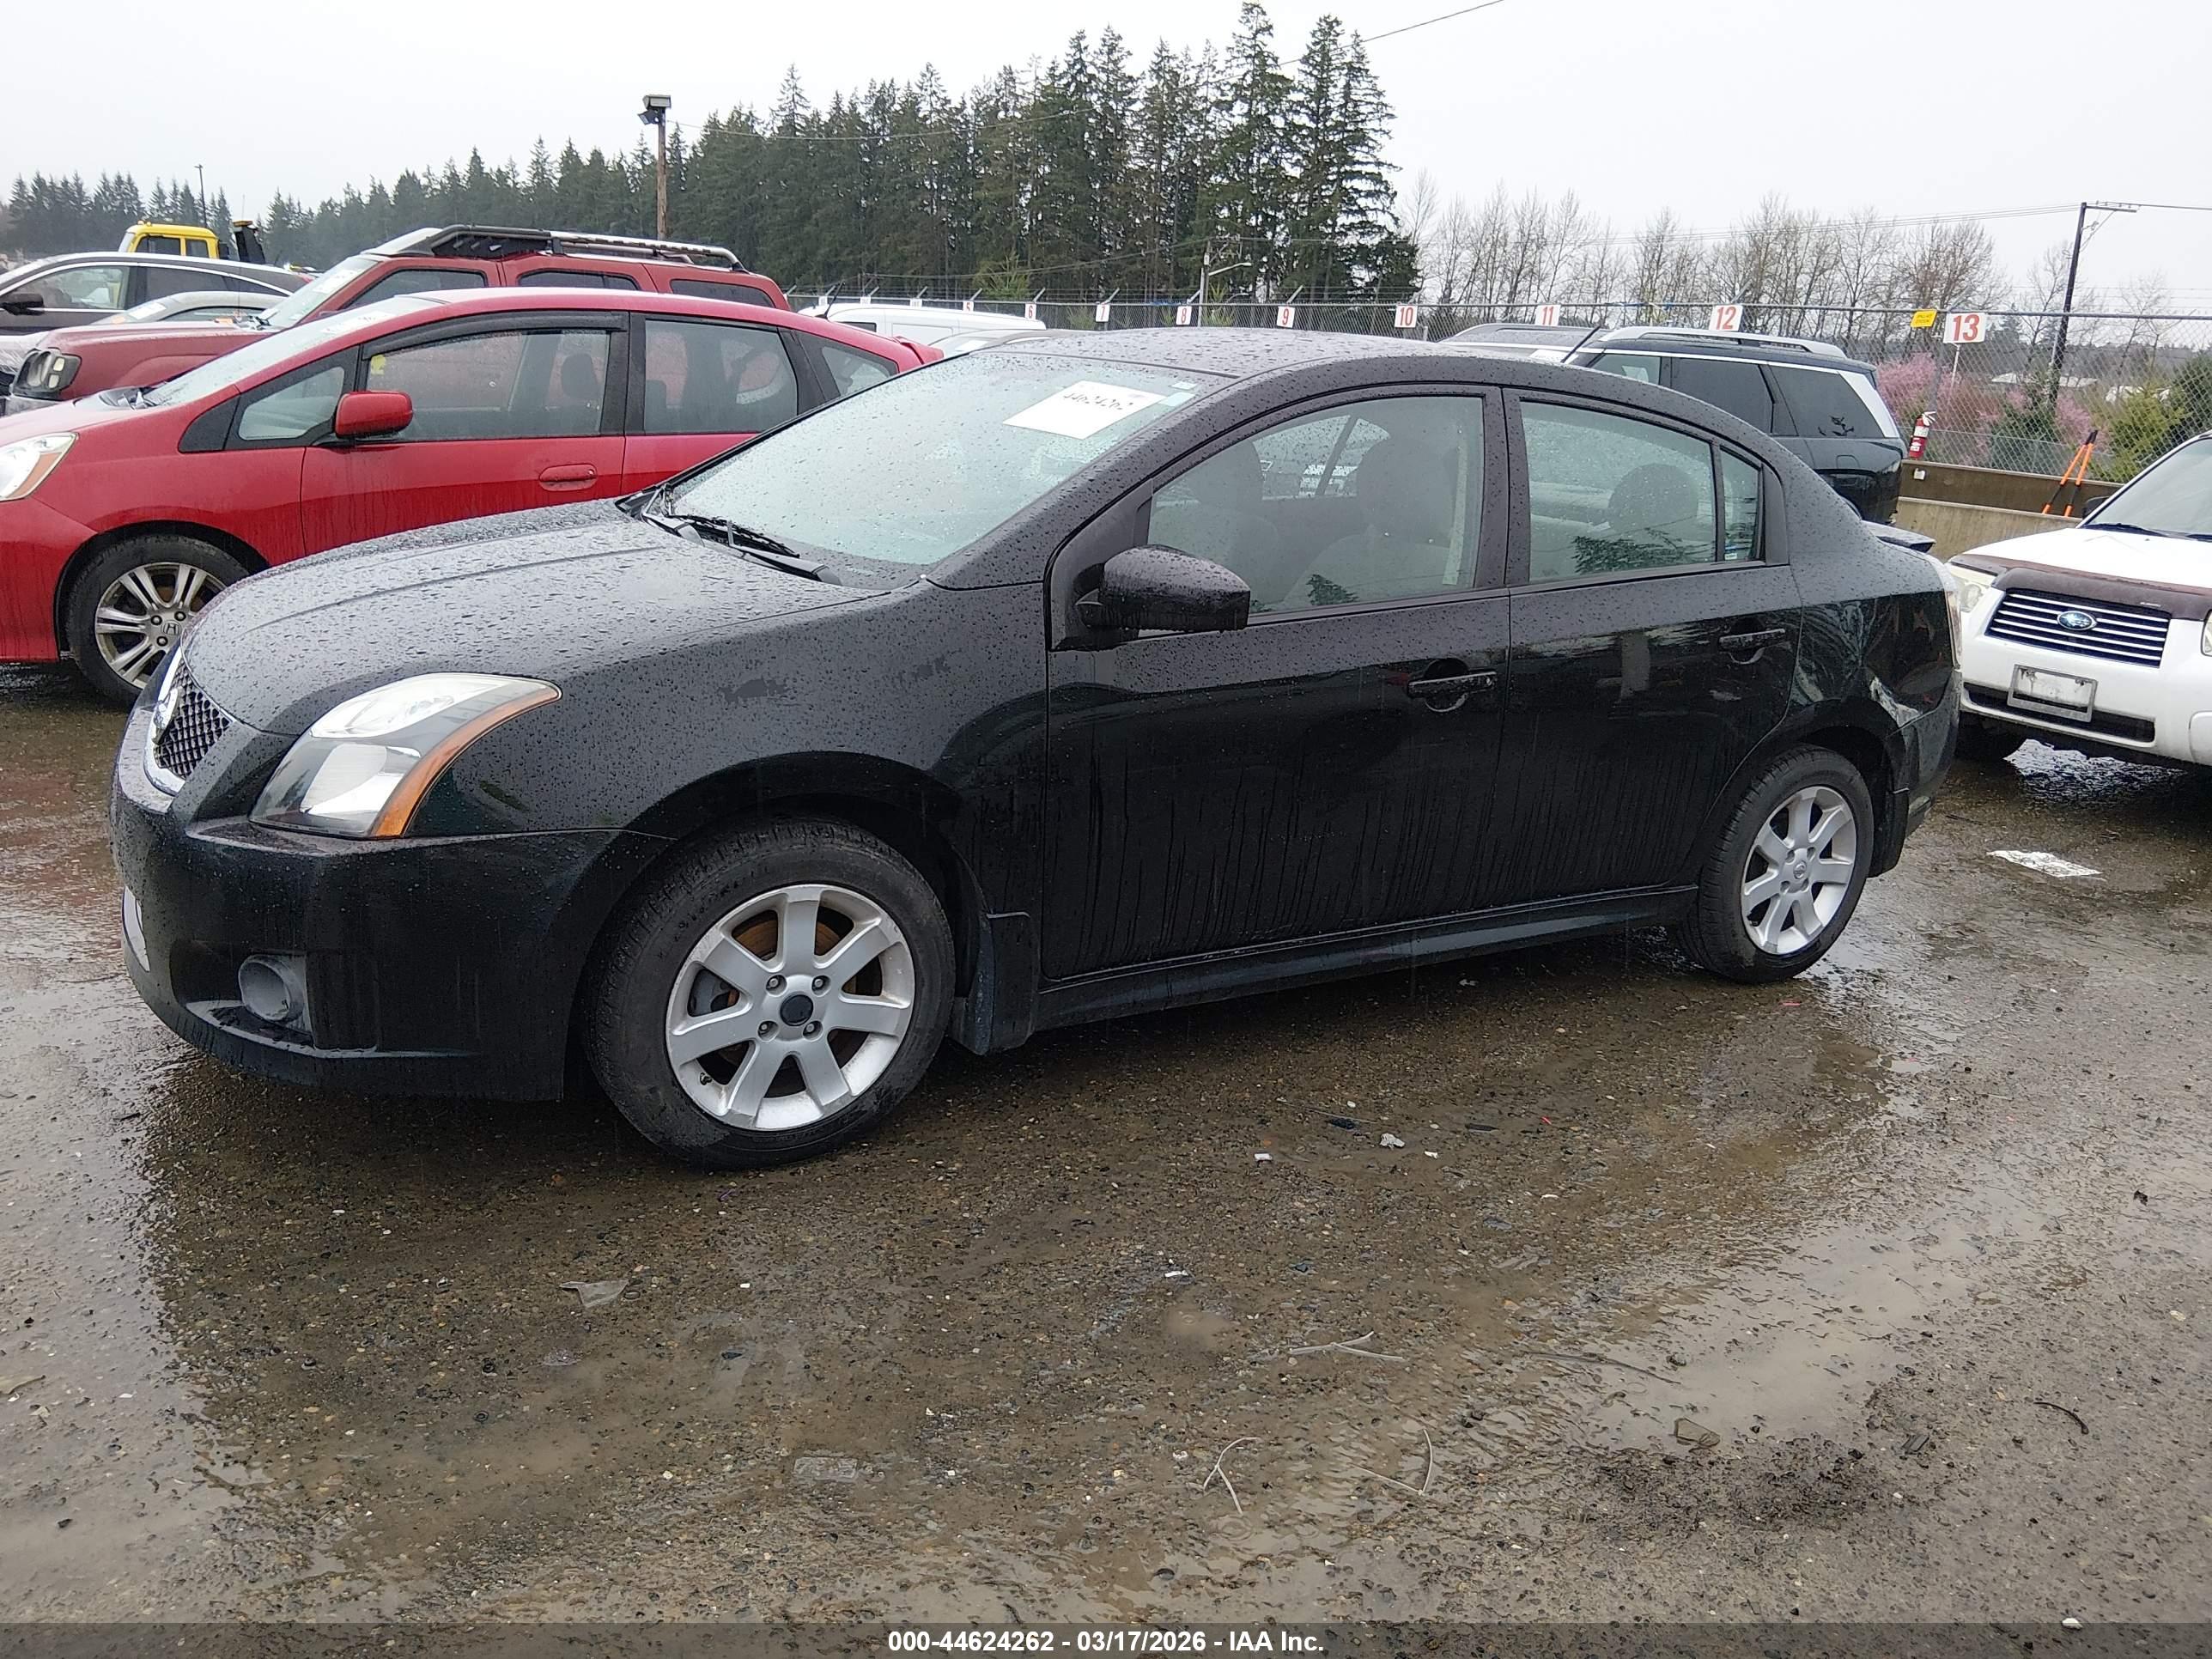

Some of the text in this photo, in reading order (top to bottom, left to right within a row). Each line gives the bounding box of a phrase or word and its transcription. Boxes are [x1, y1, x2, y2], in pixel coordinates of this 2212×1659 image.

[1029, 305, 1034, 319] 6
[1181, 307, 1188, 324] 8
[1281, 308, 1290, 325] 9
[1400, 307, 1415, 325] 10
[1542, 306, 1554, 325] 11
[1716, 307, 1736, 331] 12
[1953, 313, 1981, 342] 13
